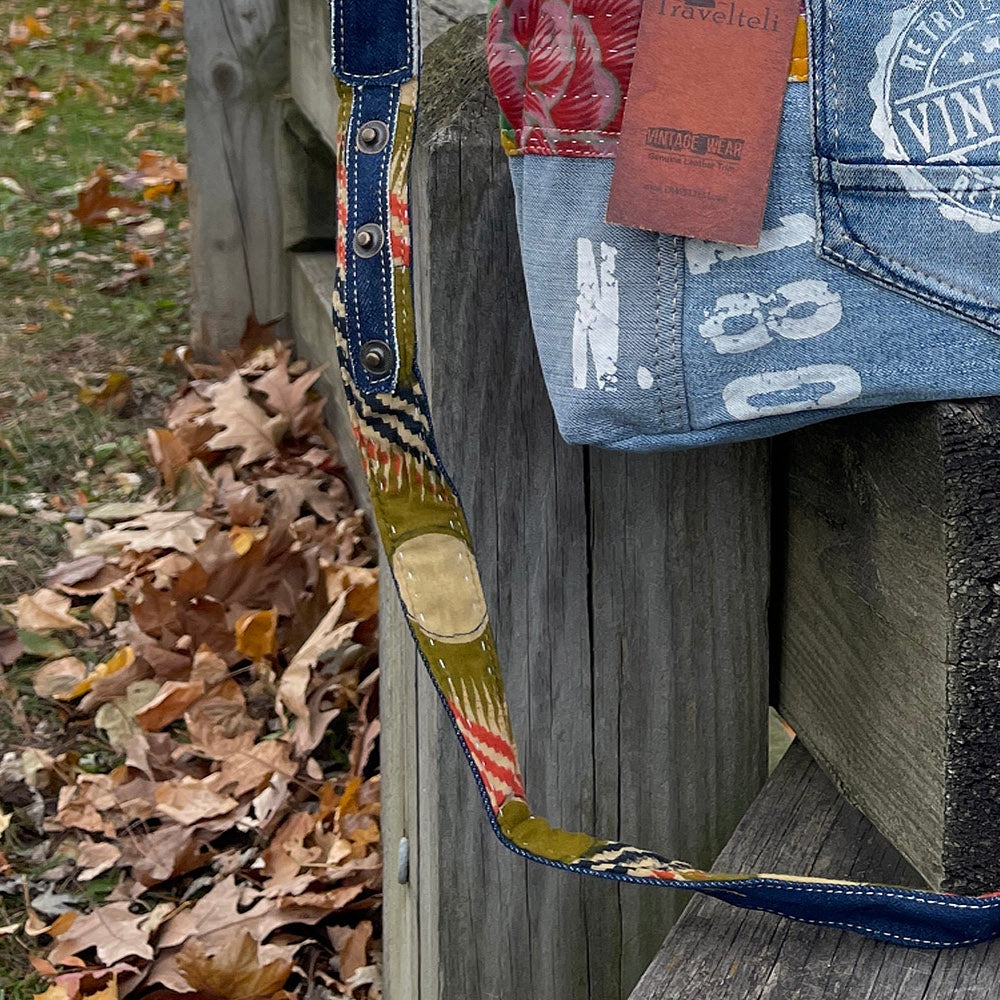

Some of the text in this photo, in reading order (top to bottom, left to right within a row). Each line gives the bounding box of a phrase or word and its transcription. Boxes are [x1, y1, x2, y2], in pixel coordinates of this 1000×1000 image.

[646, 128, 743, 158] VINTAGE WEAR
[648, 152, 682, 165] Genuine
[684, 156, 715, 169] Leather
